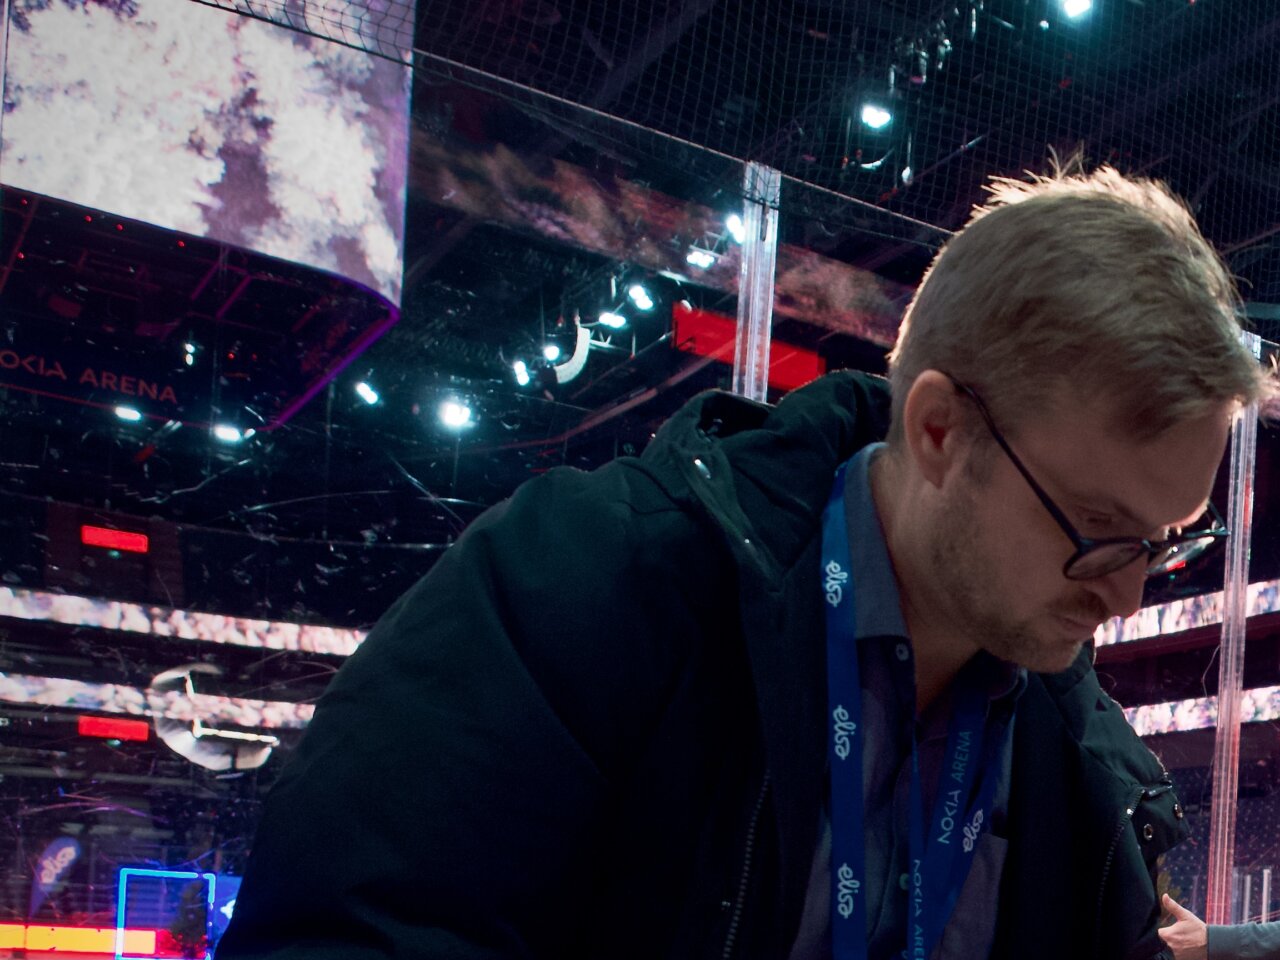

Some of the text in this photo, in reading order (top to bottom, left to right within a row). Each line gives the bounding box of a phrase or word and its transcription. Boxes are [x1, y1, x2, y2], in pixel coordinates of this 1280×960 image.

[0, 348, 178, 405] OKIA ARENA
[825, 560, 848, 608] elisa
[833, 705, 856, 760] elisa
[937, 729, 974, 844] NOKIA ARENA
[962, 808, 984, 853] elisa
[838, 863, 860, 919] elisa
[913, 858, 923, 917] NOKIA
